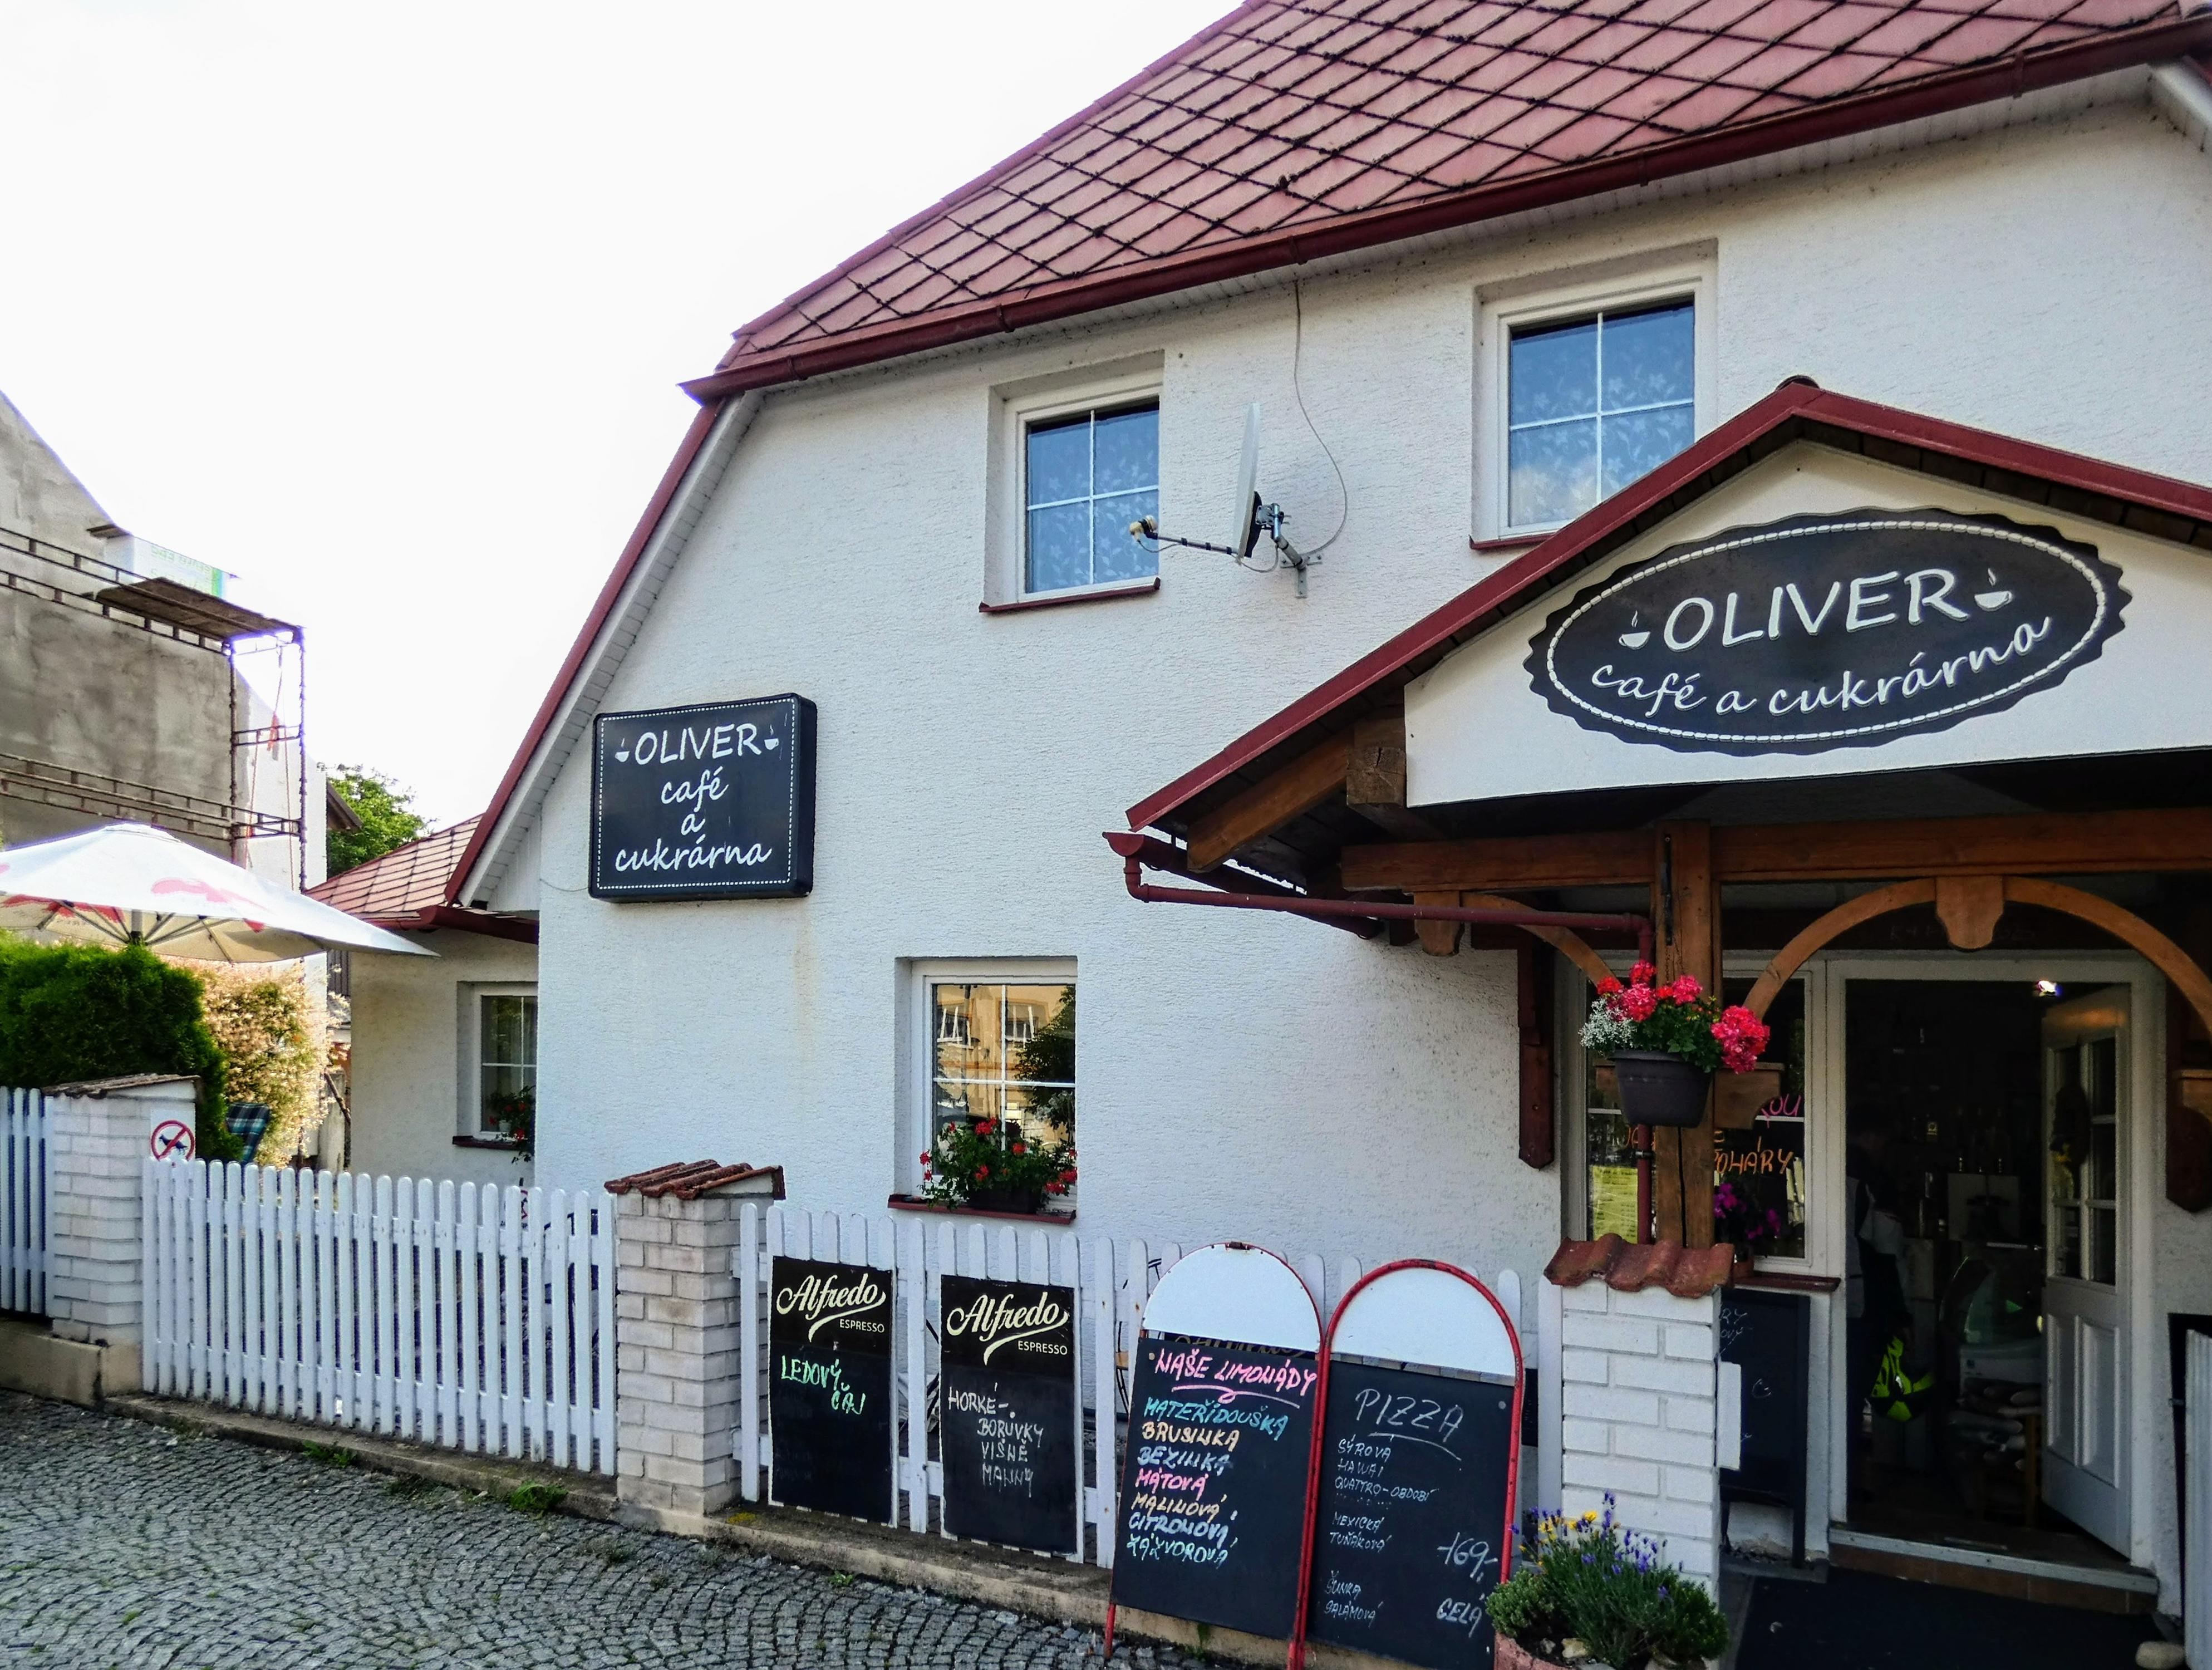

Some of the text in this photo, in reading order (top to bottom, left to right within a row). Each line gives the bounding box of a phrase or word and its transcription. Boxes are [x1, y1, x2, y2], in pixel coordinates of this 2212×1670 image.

[1664, 568, 1970, 652] OLIVER
[1591, 616, 2052, 718] café a cukrárna
[635, 723, 761, 765] OLIVER
[661, 766, 729, 812] café
[615, 834, 772, 872] cukrárna
[776, 1273, 879, 1320] Alfredo
[947, 1291, 1061, 1342] Alfredo
[839, 1318, 885, 1333] ESPRESSO
[1017, 1340, 1068, 1355] ESPRESSO
[780, 1355, 842, 1391] LEDOVÝ
[1154, 1348, 1318, 1396] NAŠE LIMONÁDY
[831, 1382, 866, 1414] ČAJ
[1354, 1388, 1466, 1443] PIZZA
